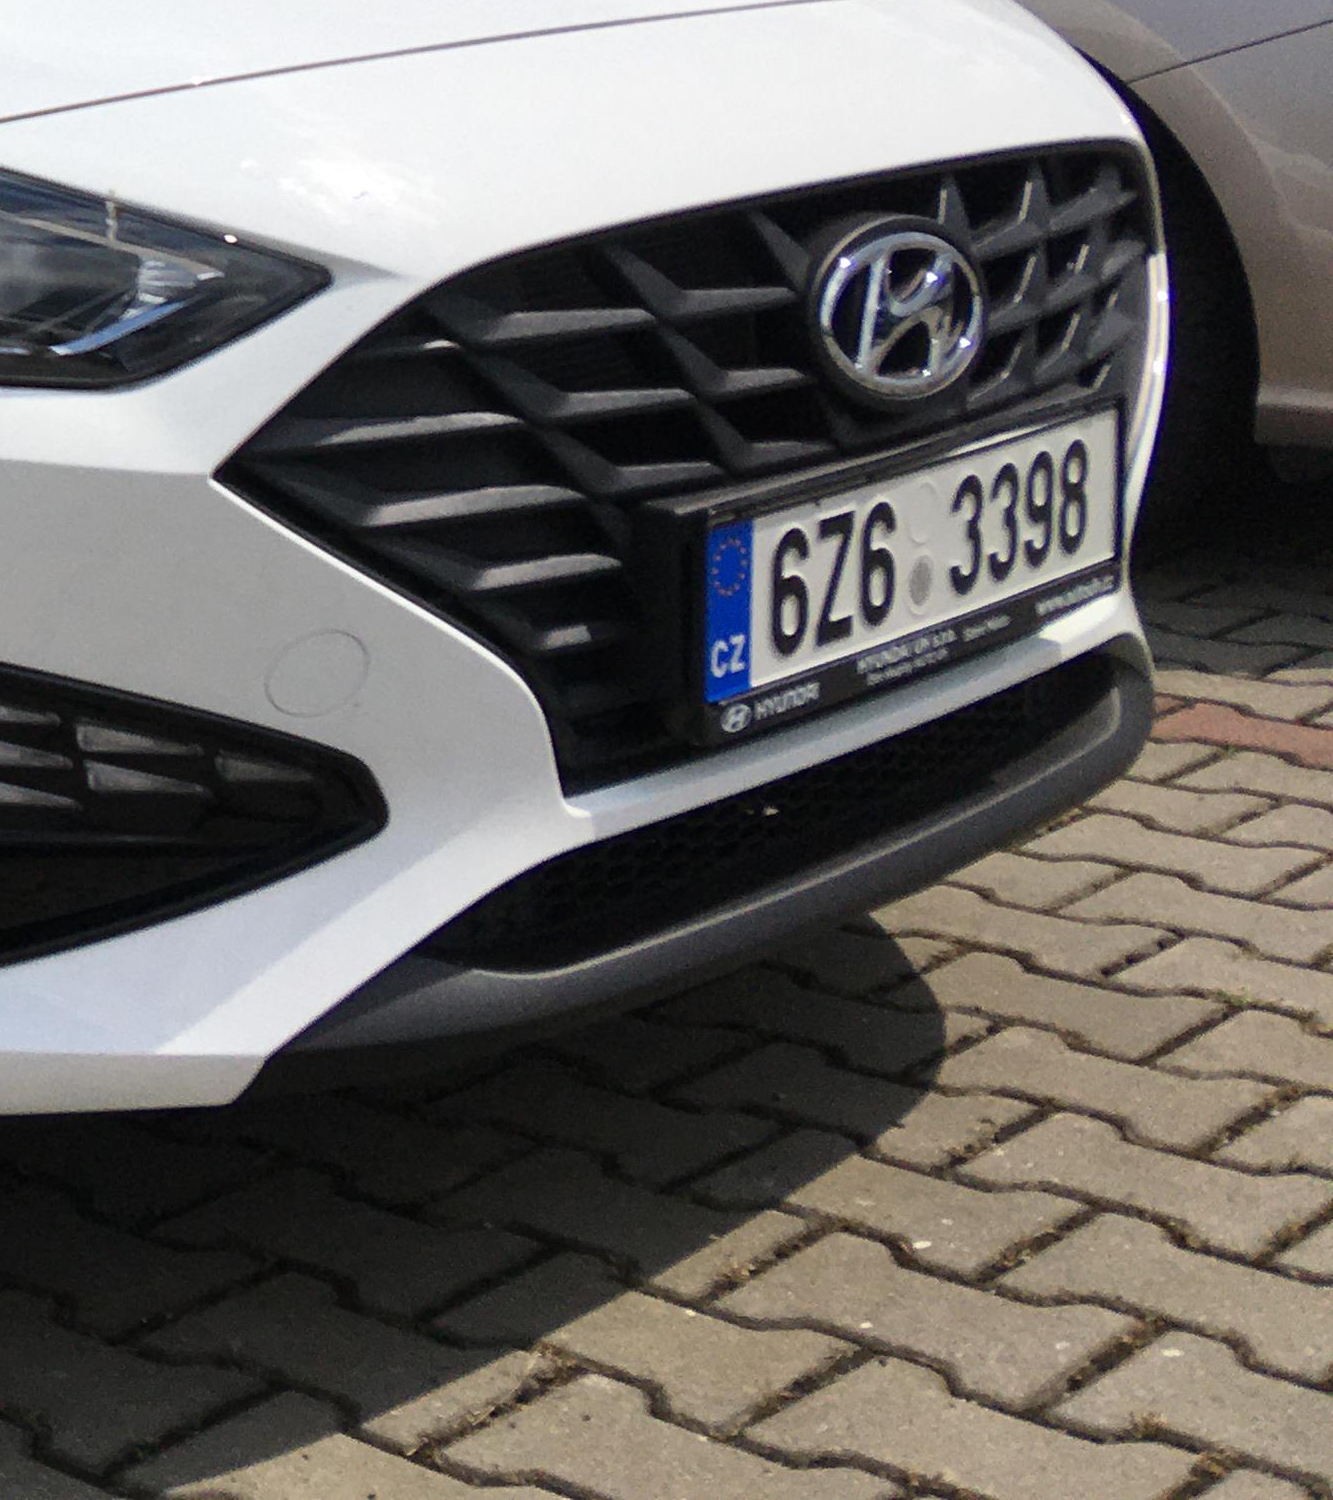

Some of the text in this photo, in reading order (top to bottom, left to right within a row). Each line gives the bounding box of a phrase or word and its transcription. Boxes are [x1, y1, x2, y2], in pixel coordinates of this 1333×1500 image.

[771, 439, 1088, 657] 6Z6 3398
[710, 635, 746, 678] CZ
